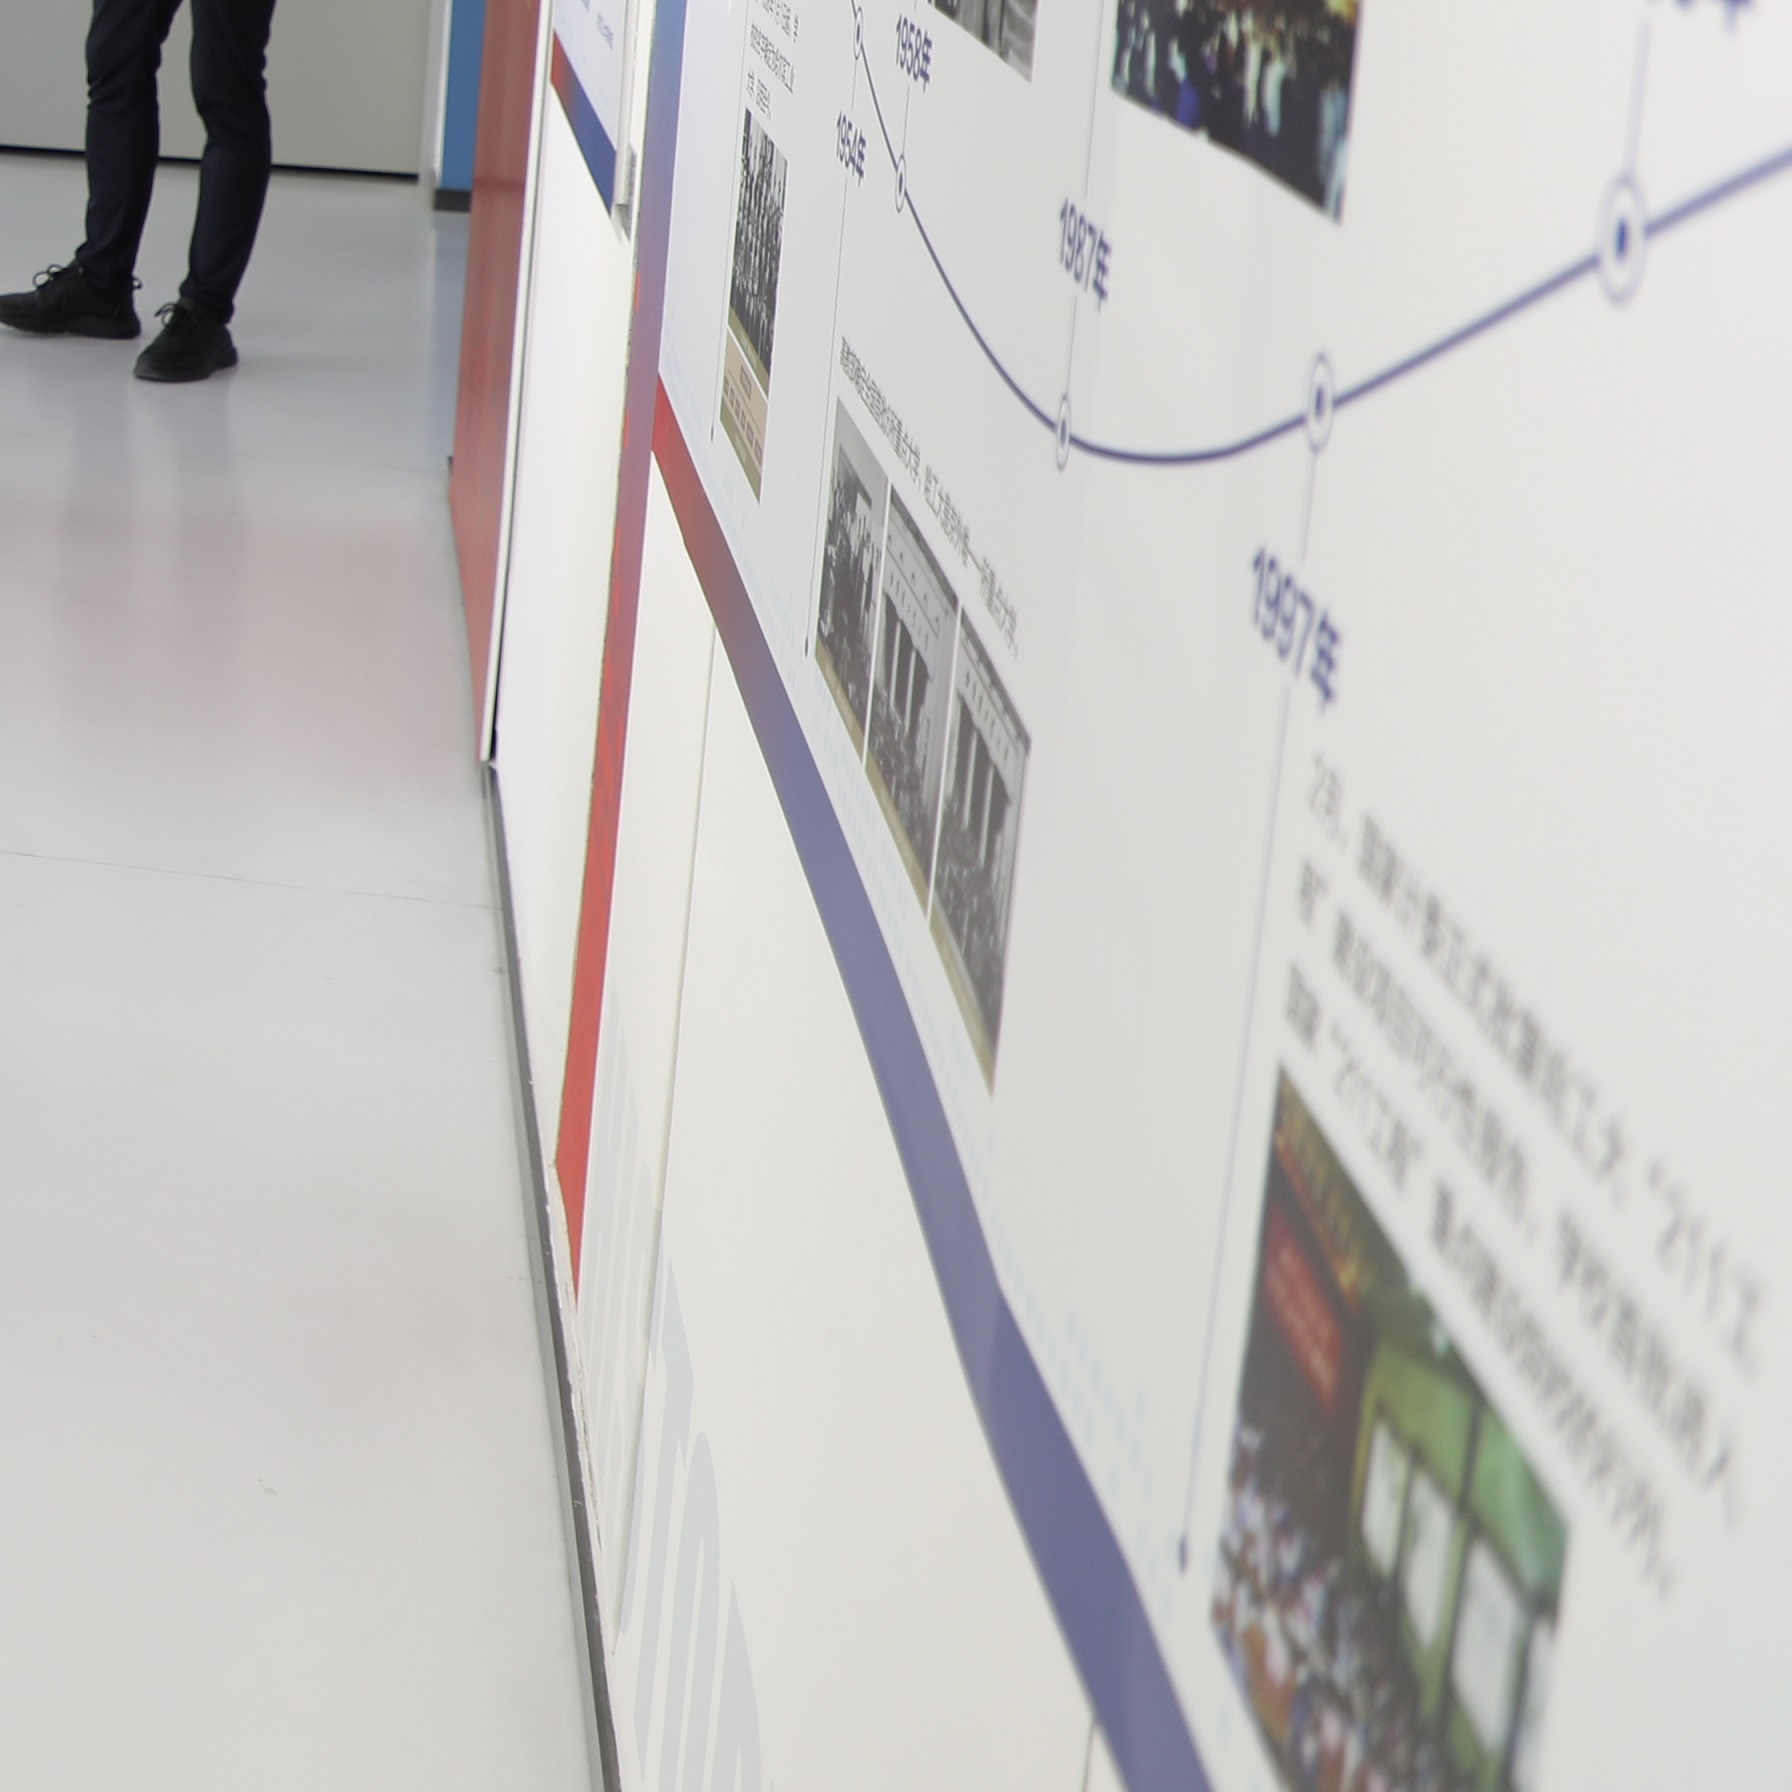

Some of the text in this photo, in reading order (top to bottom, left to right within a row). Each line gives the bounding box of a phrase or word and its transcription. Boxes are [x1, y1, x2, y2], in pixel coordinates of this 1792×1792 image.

[896, 13, 933, 93] 1958年
[835, 110, 868, 188] 1954年
[1058, 198, 1111, 312] 1987年
[1251, 547, 1344, 715] 1997年
